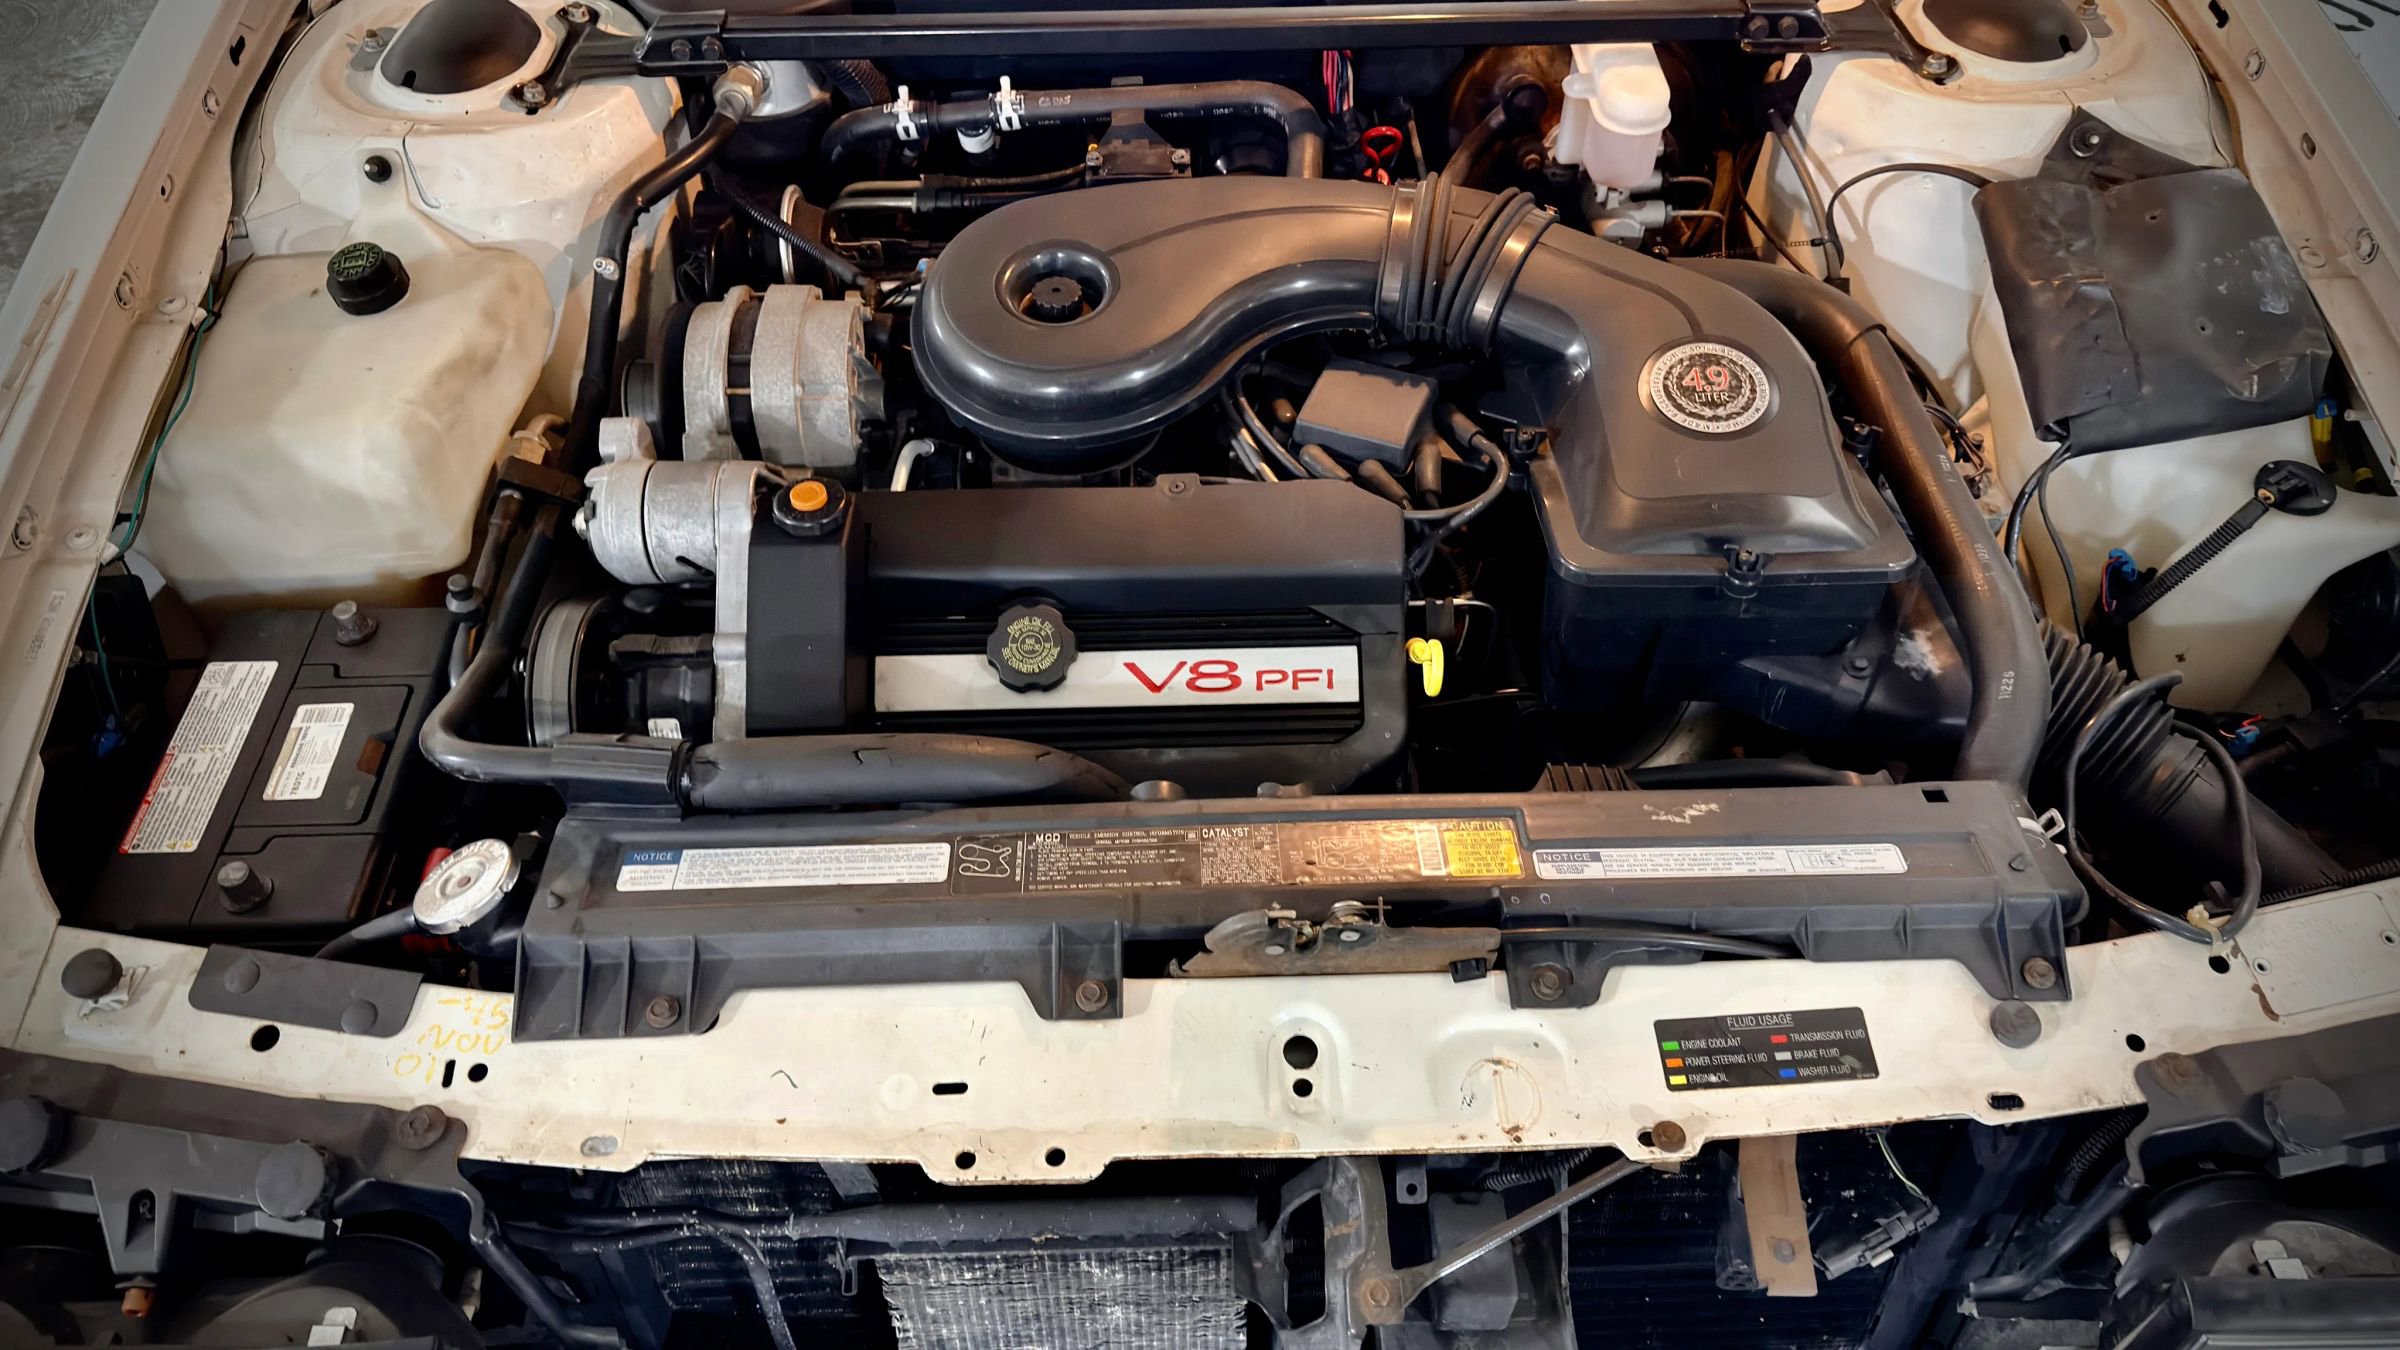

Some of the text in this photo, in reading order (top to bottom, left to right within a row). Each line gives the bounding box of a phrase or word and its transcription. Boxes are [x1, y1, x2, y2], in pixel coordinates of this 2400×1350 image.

[1682, 365, 1729, 392] 4.9
[1694, 392, 1729, 403] LITER
[1007, 616, 1029, 633] ENGINE
[1123, 660, 1334, 693] V8 PFI
[1202, 827, 1249, 838] CATALYST
[1449, 821, 1503, 831] CAUTION
[1035, 832, 1061, 843] MCD
[633, 852, 673, 862] NOTICE
[1543, 852, 1592, 861] NOTICE
[1727, 1013, 1793, 1028] FLUID USAGE
[1790, 1029, 1865, 1042] TRANSMISSION FLUID
[1681, 1037, 1741, 1050] ENGINE COOLANT
[1685, 1052, 1768, 1067] POWER STEERING FLUID
[1794, 1047, 1840, 1060] BRAKE FLUID
[1716, 1072, 1728, 1082] OIL
[1798, 1064, 1851, 1077] WASHER FLUID
